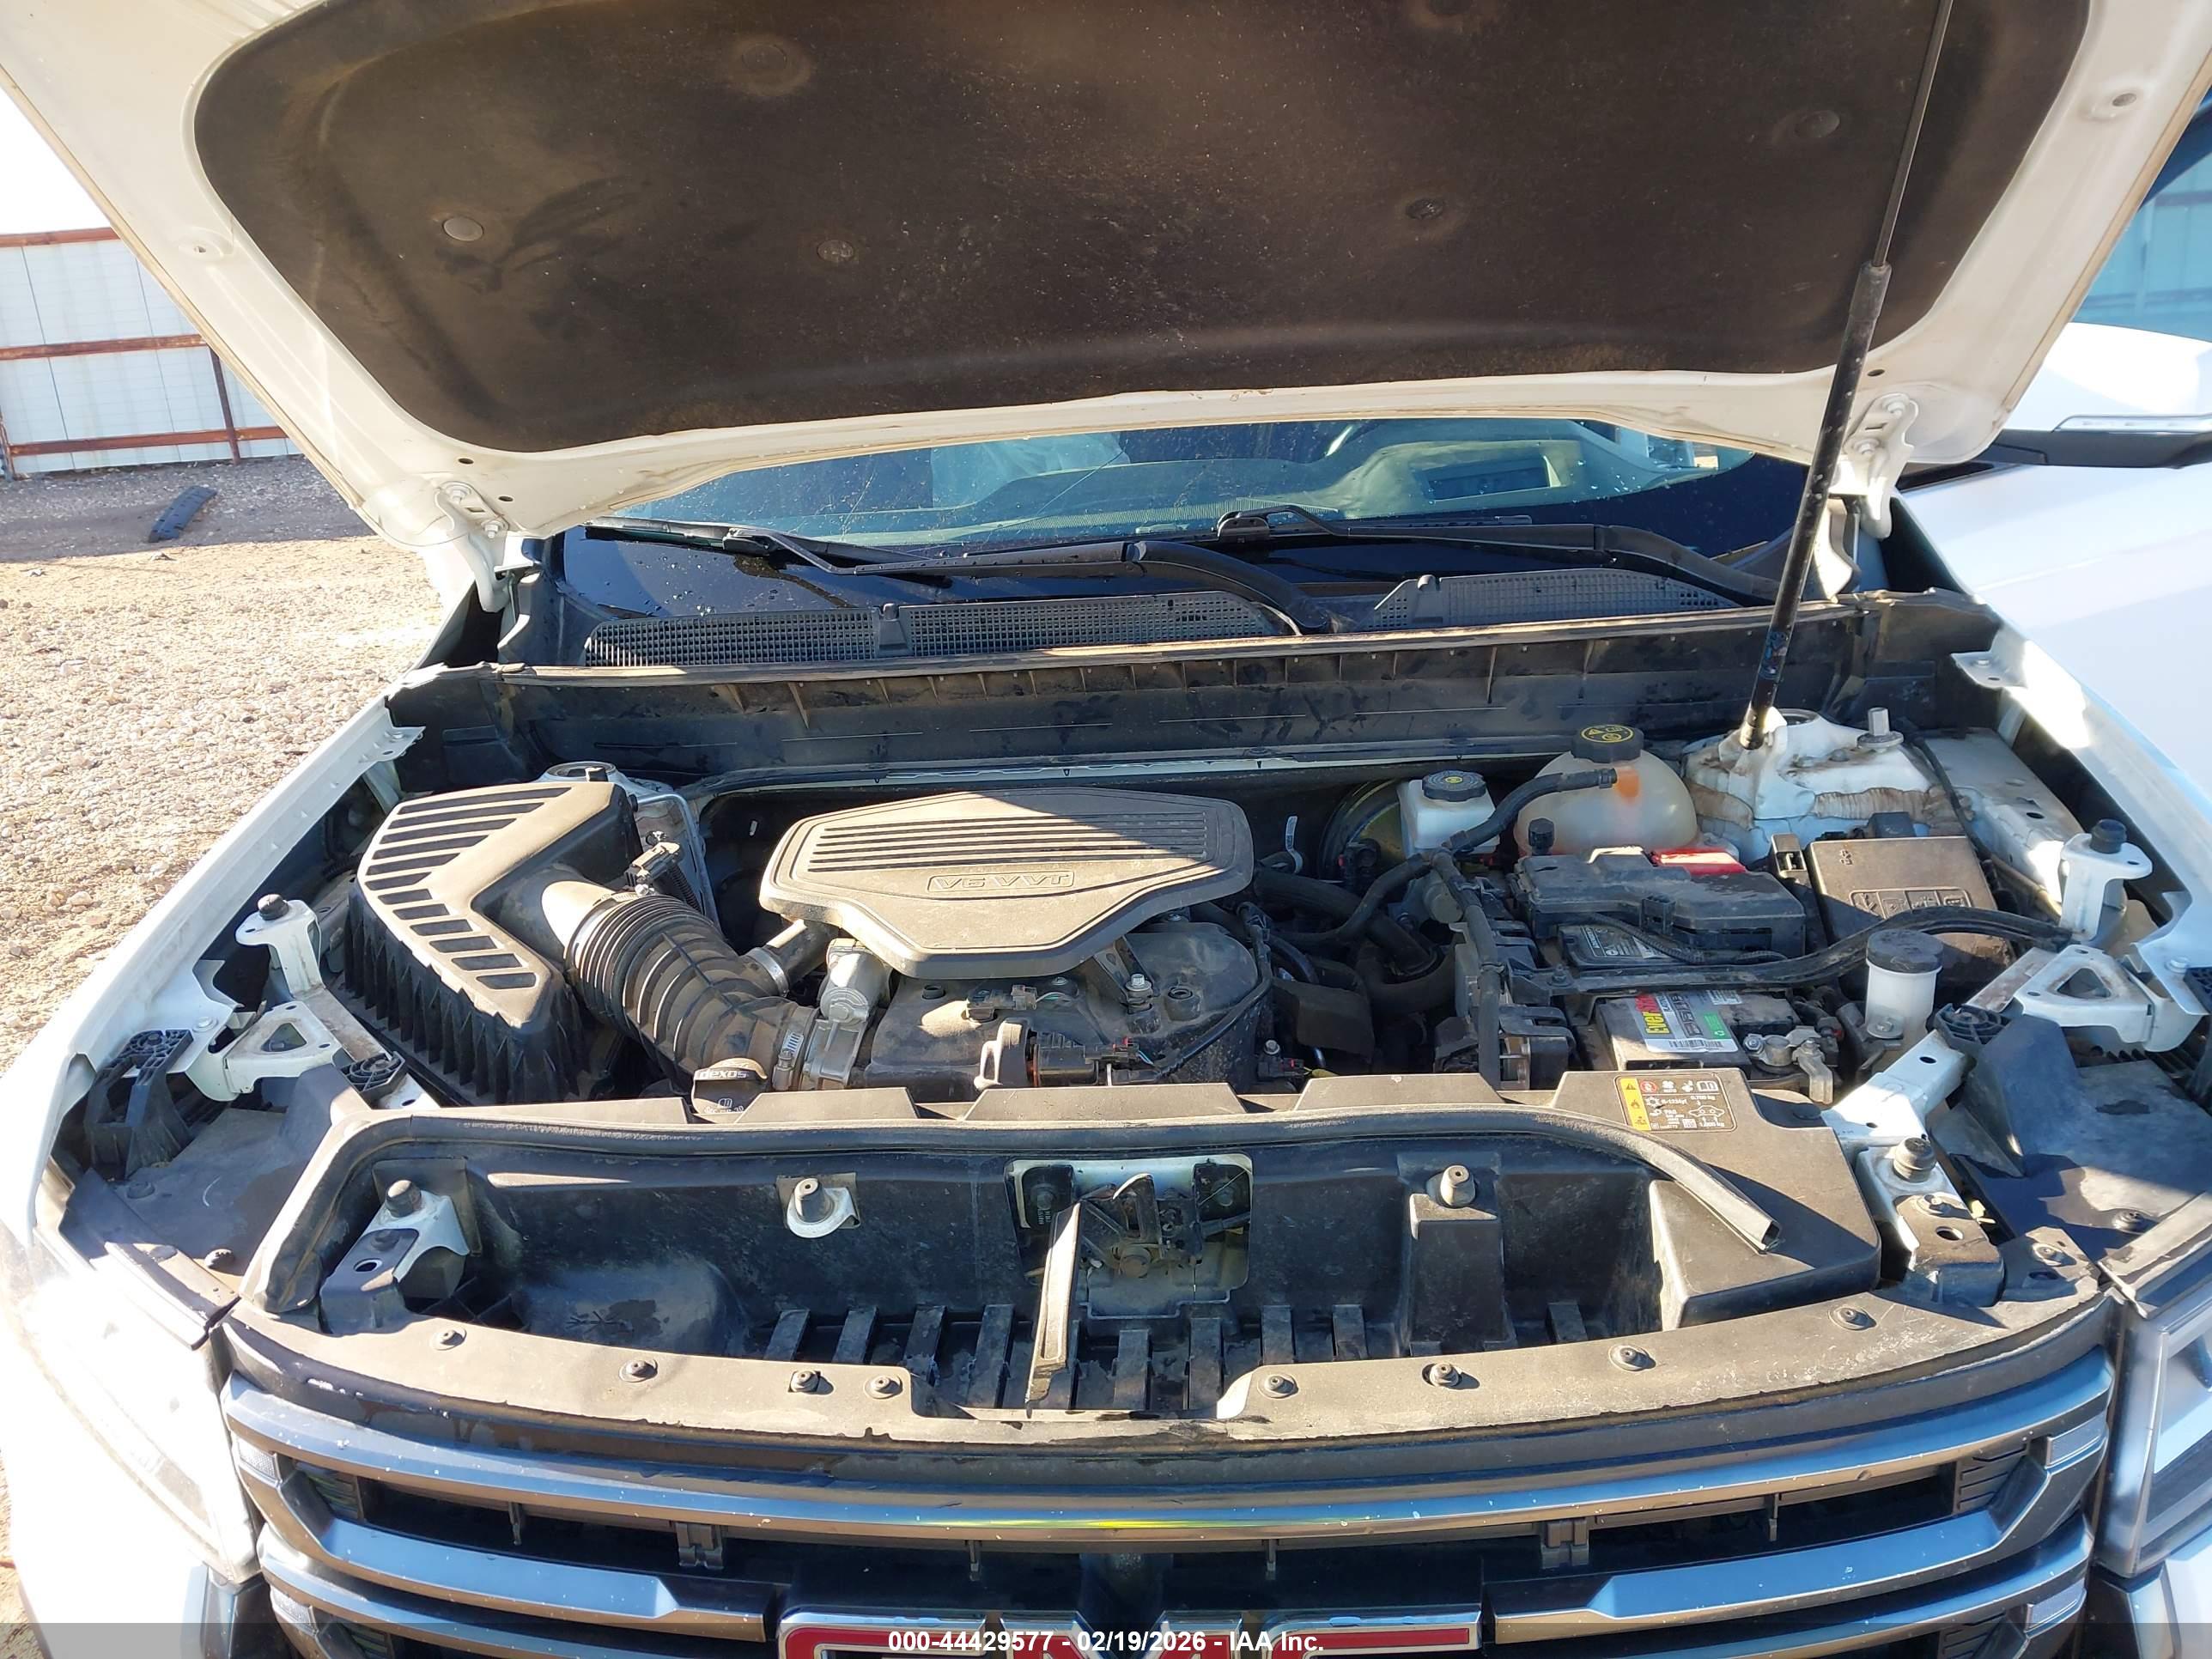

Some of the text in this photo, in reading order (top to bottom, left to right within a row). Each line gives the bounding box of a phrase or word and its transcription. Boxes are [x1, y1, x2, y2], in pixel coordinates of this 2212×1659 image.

[933, 874, 1070, 890] V6 VVT
[699, 1070, 748, 1079] dexos
